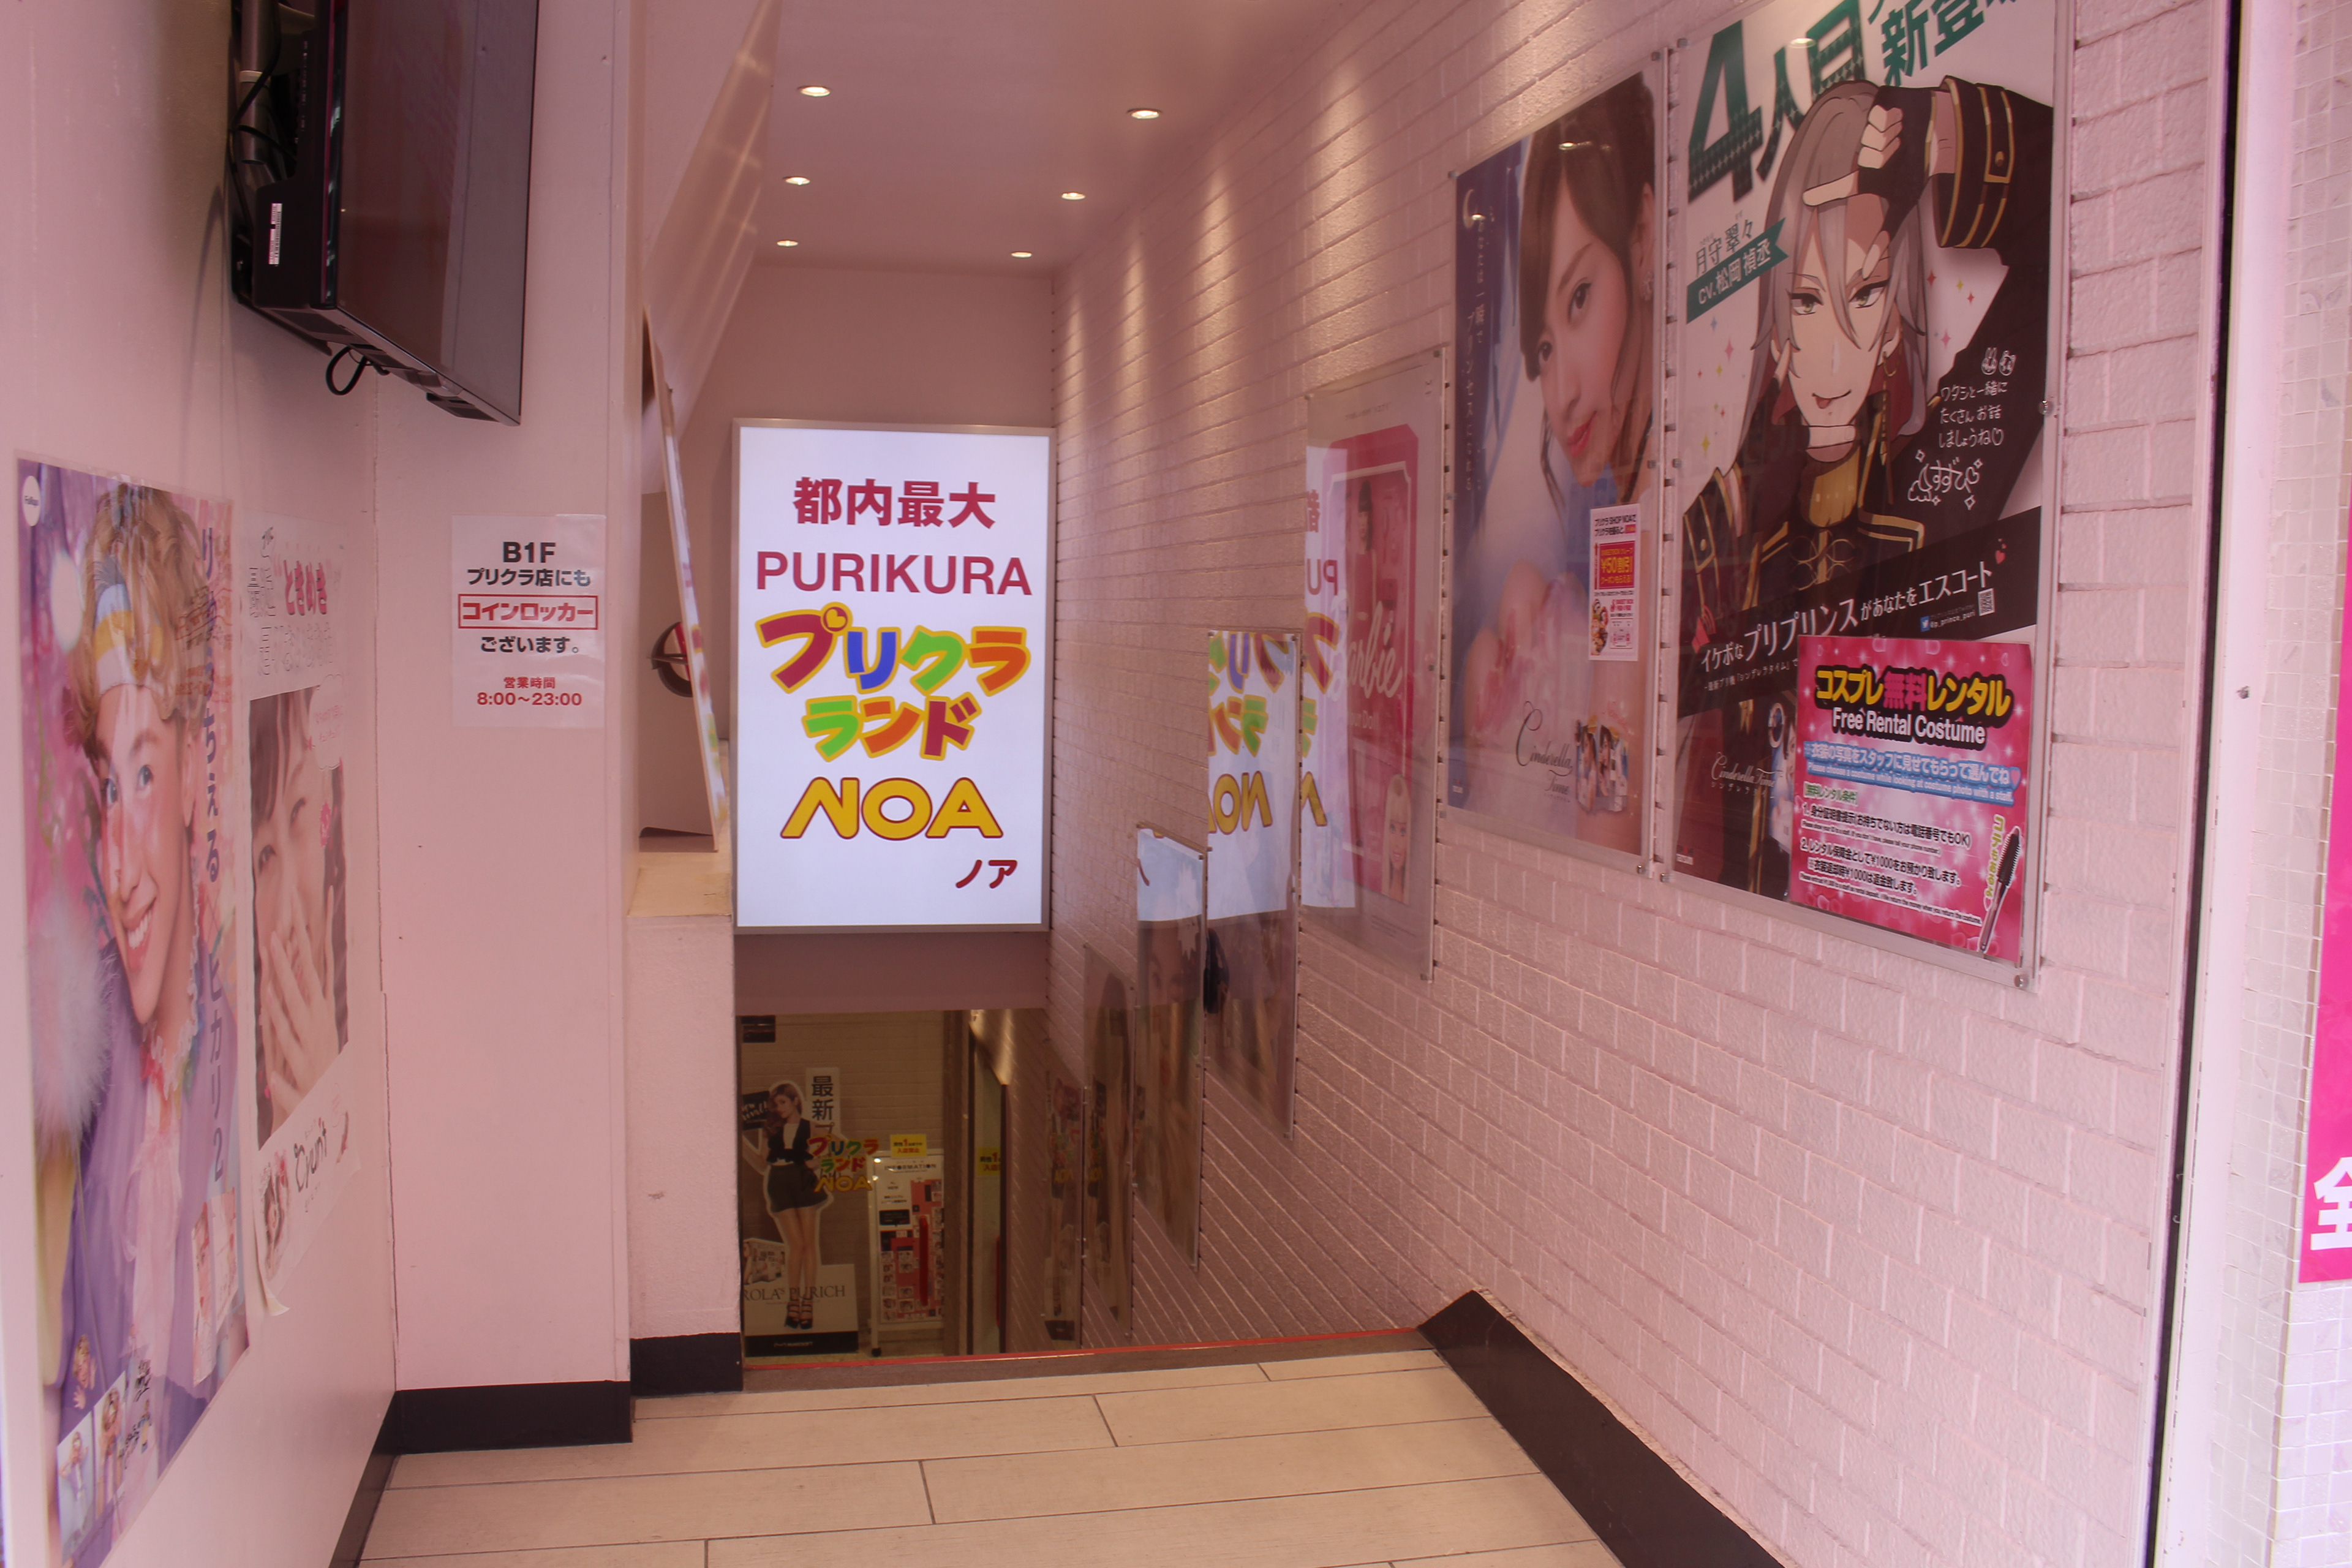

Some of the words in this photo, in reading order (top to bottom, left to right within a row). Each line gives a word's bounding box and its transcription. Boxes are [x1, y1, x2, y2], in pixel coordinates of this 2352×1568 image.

[1940, 380, 2008, 401] ワタシと一緒に
[793, 477, 997, 529] 都内最大
[502, 541, 556, 564] B1F
[1600, 556, 1634, 573] ¥50割引
[467, 567, 591, 587] プリクラ店にも
[757, 551, 1032, 596] PURIKURA
[283, 559, 327, 616] ときめき
[462, 602, 594, 622] コインロッカー
[480, 636, 579, 654] ございます。
[755, 601, 1031, 696] プリクラ
[503, 677, 556, 689] 営業時間
[1816, 669, 2011, 717] コスプレ無料レンタル
[802, 692, 982, 762] ランド
[1516, 701, 1574, 769] Cinderella
[1833, 707, 1864, 730] Free
[1866, 710, 1912, 736] Rental
[1915, 715, 1986, 745] Costume
[780, 777, 1003, 841] NOA
[956, 859, 1017, 889] ノア
[807, 1134, 880, 1157] プリクラ
[820, 1156, 867, 1174] ランド
[814, 1175, 872, 1193] NOA
